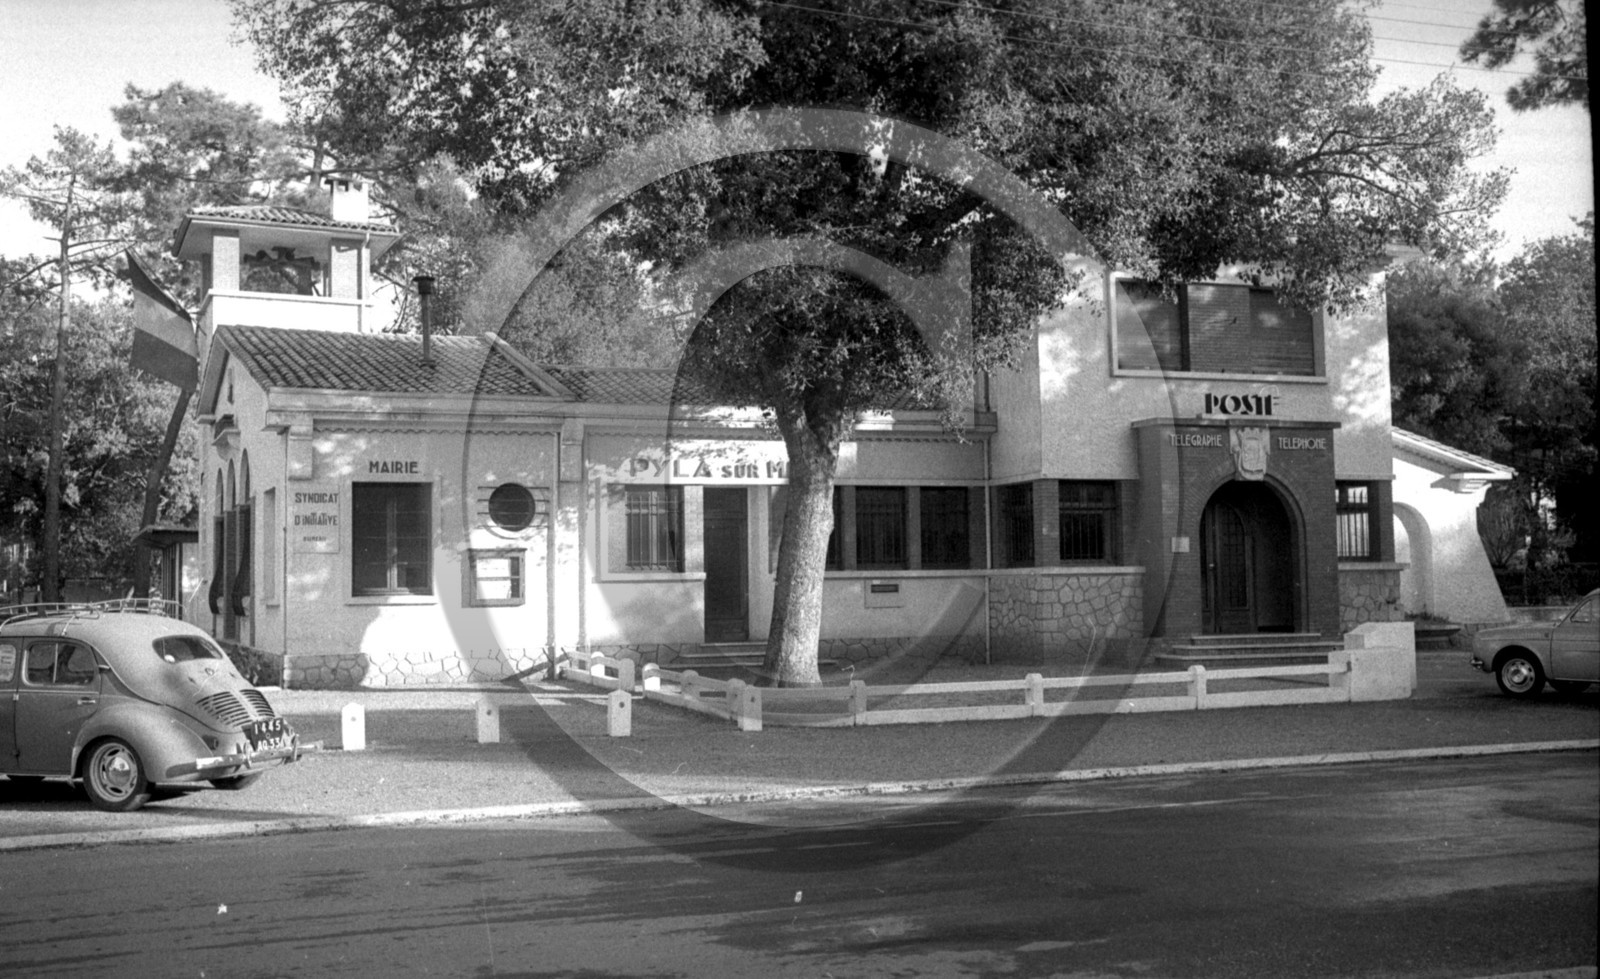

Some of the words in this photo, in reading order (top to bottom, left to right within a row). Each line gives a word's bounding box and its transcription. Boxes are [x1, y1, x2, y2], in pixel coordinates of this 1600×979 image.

[1205, 393, 1280, 415] POSTE
[369, 461, 418, 474] MAIRIE
[629, 456, 713, 478] PYLA
[721, 463, 760, 479] SUR
[295, 493, 339, 504] SYNDICAT
[254, 719, 281, 735] 1445
